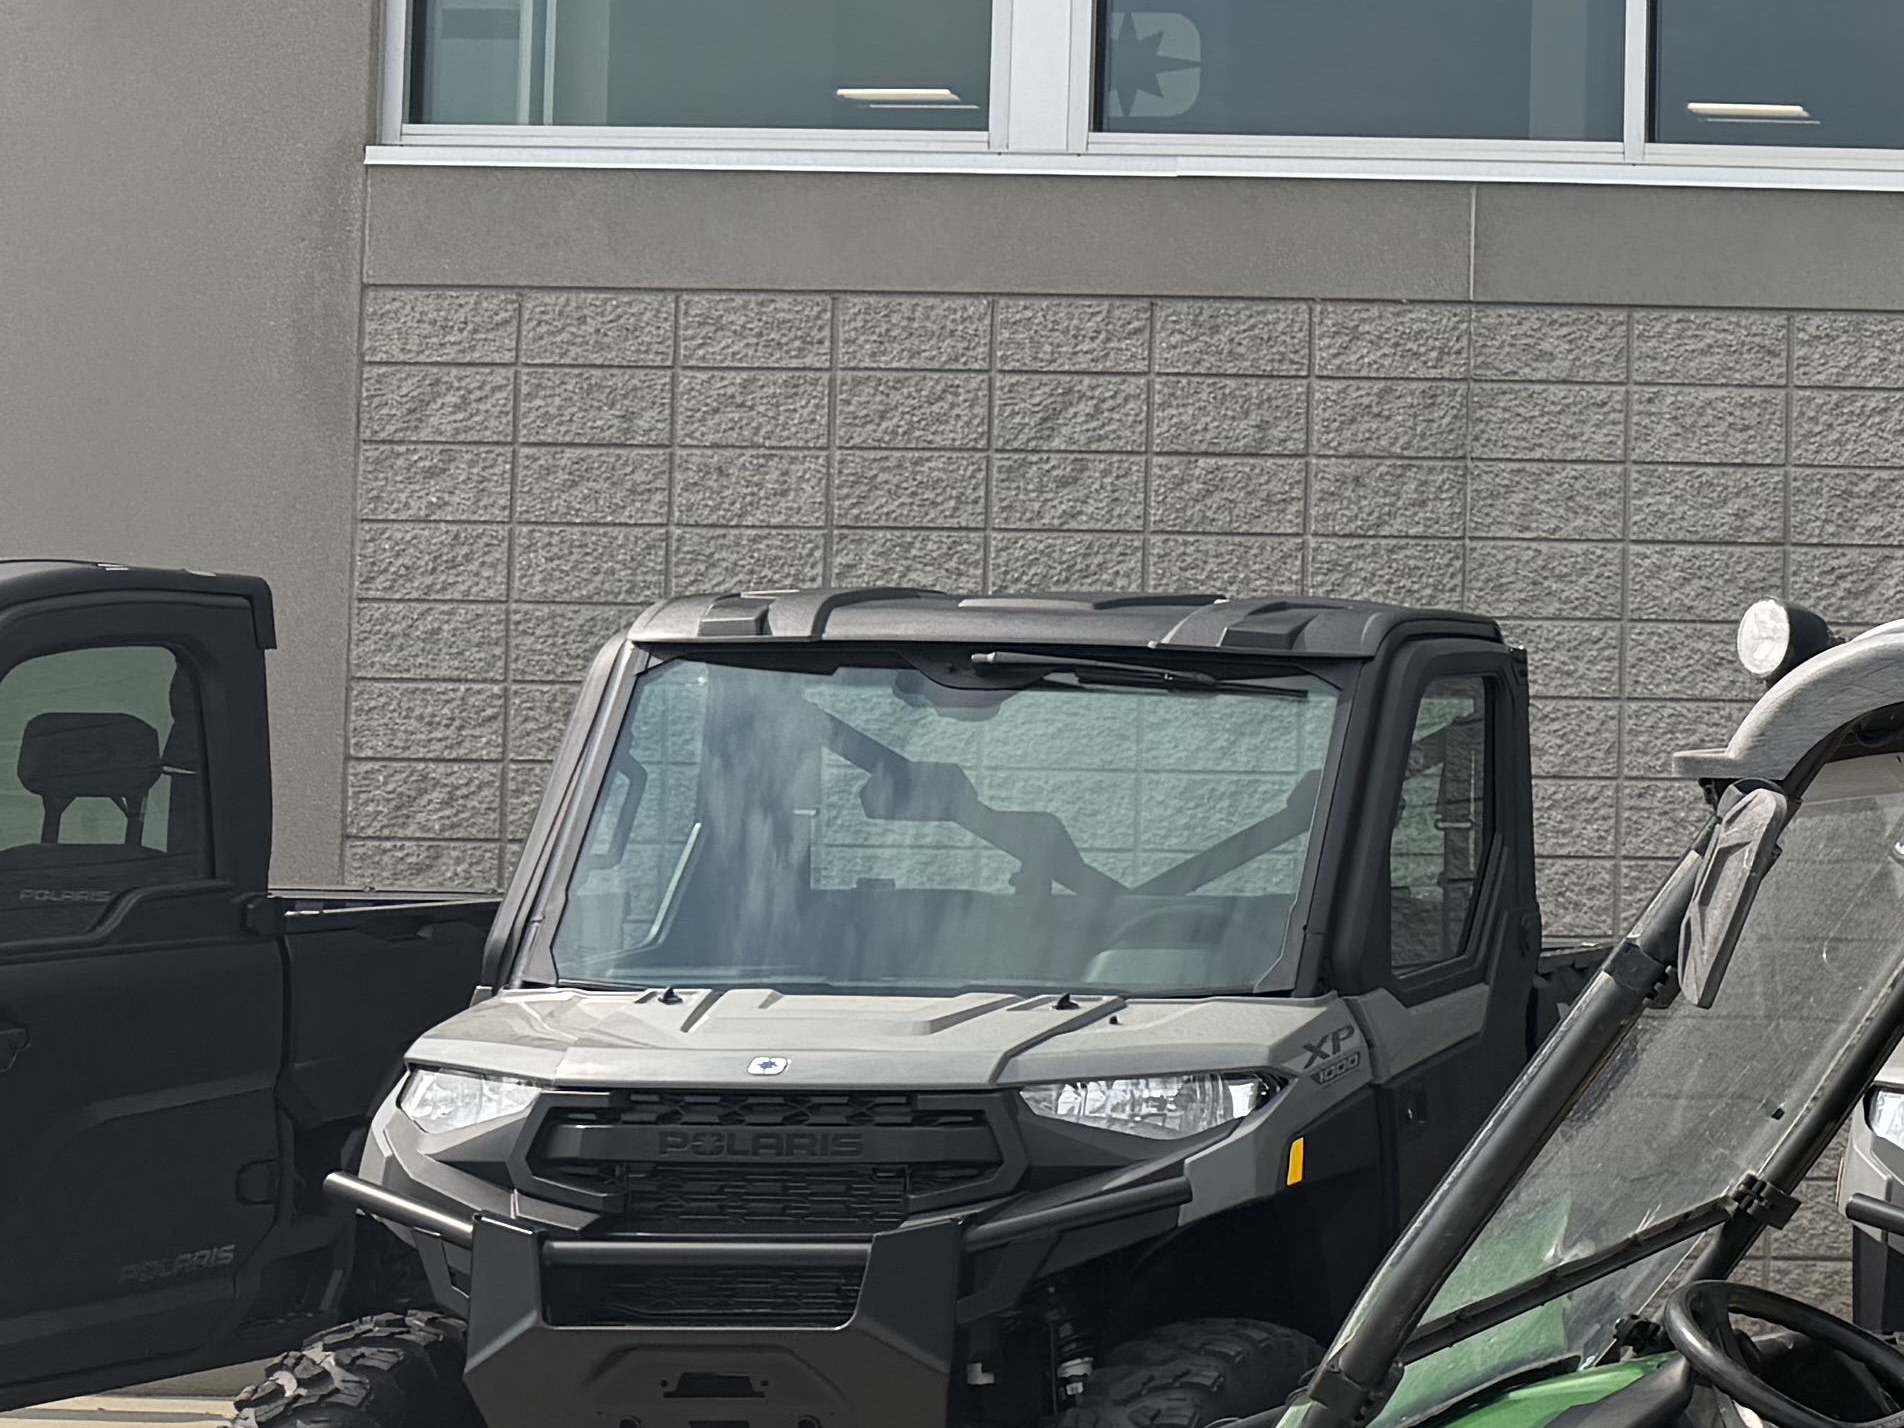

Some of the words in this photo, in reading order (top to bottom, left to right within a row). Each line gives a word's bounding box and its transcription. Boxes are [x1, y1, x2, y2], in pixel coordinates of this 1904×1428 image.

[20, 888, 112, 903] POLARIS
[1302, 1025, 1355, 1069] XP
[1318, 1053, 1359, 1082] 1000
[659, 1132, 864, 1158] POLARIS
[119, 1243, 237, 1285] POLARIS
